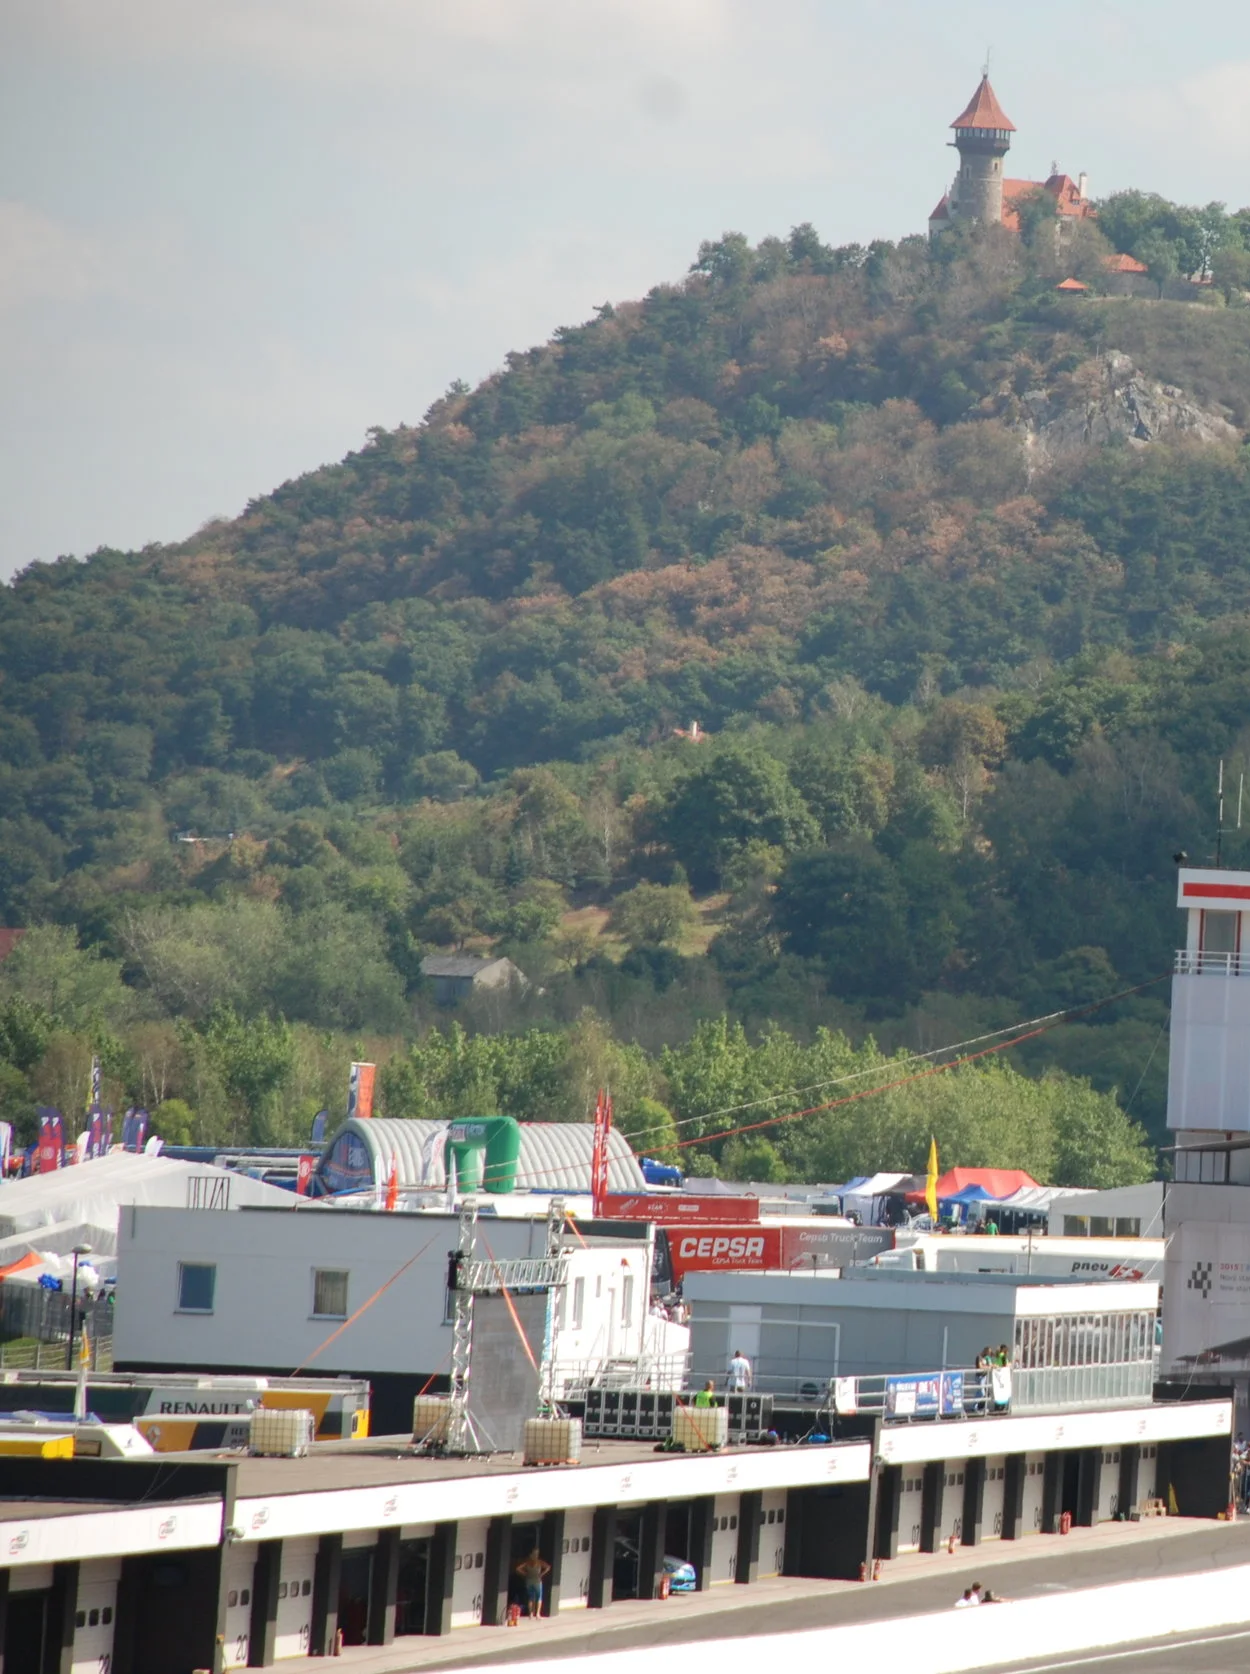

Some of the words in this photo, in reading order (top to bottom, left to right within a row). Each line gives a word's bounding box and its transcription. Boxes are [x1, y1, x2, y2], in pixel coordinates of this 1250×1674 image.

[679, 1236, 765, 1258] CEPSA
[830, 1232, 856, 1242] Truck
[859, 1233, 883, 1244] Team
[1071, 1261, 1109, 1272] pneu
[160, 1401, 244, 1415] RENAULT
[774, 1547, 784, 1573] 10
[298, 1622, 310, 1650] 19
[235, 1634, 248, 1661] 20
